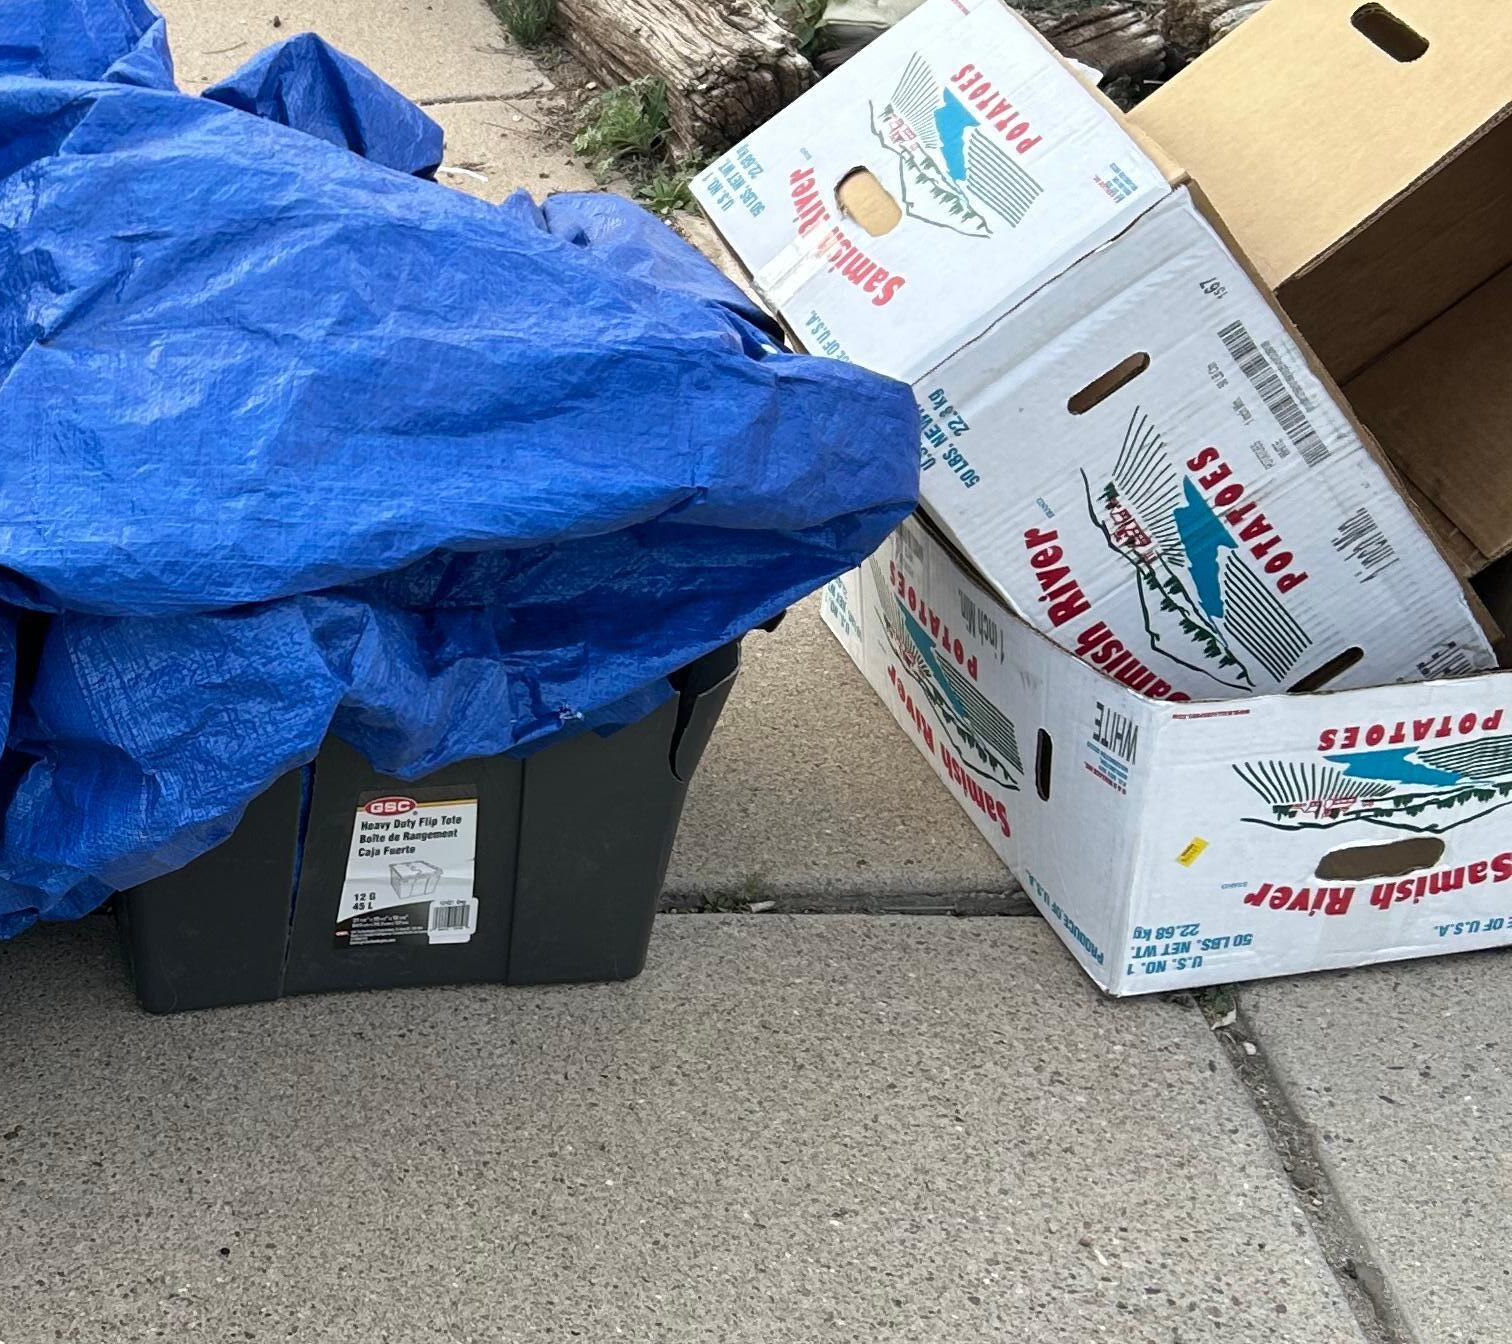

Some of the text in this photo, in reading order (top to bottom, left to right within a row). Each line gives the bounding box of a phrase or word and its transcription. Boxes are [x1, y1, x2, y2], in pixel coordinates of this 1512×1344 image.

[951, 63, 1043, 154] POTATOES
[750, 201, 765, 217] 50
[806, 310, 840, 355] OF U.S.A.
[928, 388, 948, 411] kg
[942, 443, 969, 474] LBS.
[960, 468, 980, 489] 50
[1186, 446, 1309, 594] POTATOES
[1344, 532, 1395, 577] inch
[1024, 528, 1091, 627] River
[1360, 558, 1400, 584] 1
[890, 560, 978, 682] POTATOES
[1075, 620, 1191, 701] amish
[1093, 701, 1138, 765] WHITE
[1317, 709, 1504, 752] POTATOES
[888, 664, 1011, 838] Samish River
[370, 801, 411, 814] GSC
[361, 815, 462, 831] Heavy Duty Flip Tote
[388, 832, 400, 842] de
[403, 829, 458, 841] Rangement
[358, 845, 416, 858] Caja Fuerte
[1243, 852, 1512, 917] Samish River
[352, 902, 365, 910] 45
[354, 892, 366, 902] 12
[1051, 903, 1063, 920] OF
[1133, 923, 1200, 941] 22.68 kg
[1433, 919, 1480, 938] U.S.A.
[1483, 917, 1504, 932] OF
[1064, 914, 1104, 966] PRODUCE
[1131, 933, 1253, 959] 50 LBS. NET WT.
[1141, 960, 1166, 975] NO.
[1172, 956, 1203, 971] U.S.
